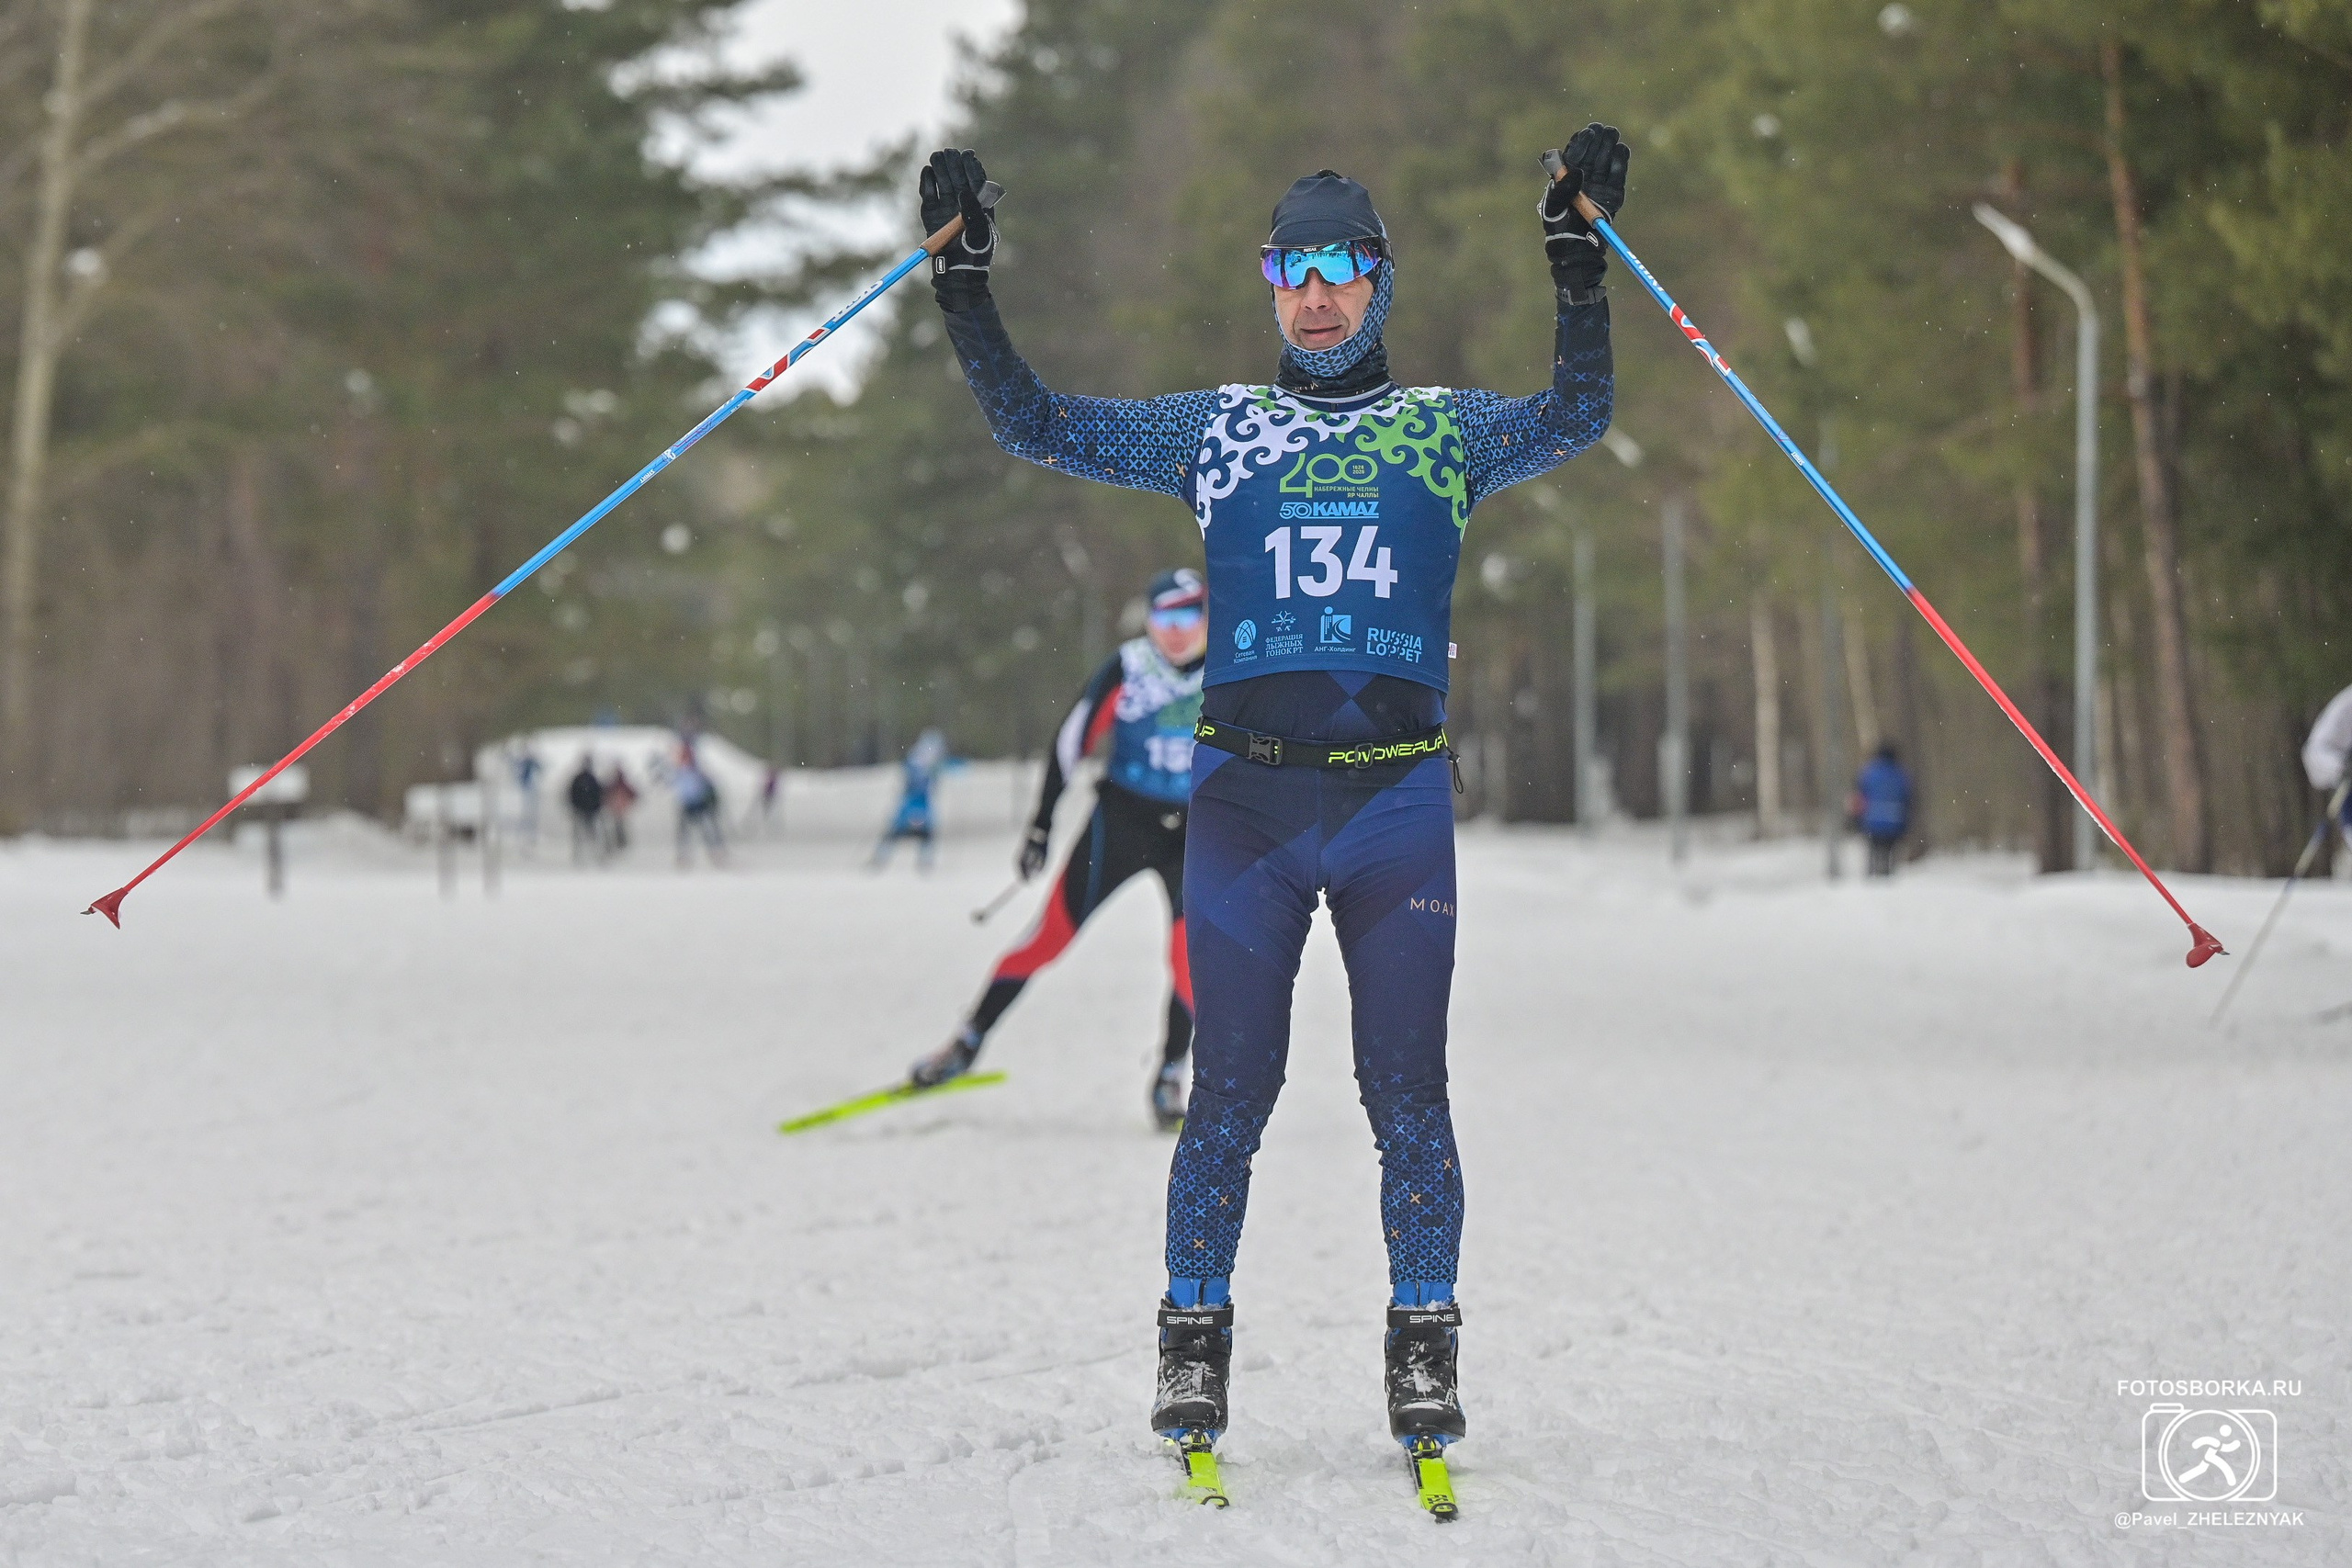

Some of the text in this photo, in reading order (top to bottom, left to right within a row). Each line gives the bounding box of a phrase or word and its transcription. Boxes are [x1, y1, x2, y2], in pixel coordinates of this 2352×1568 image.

[1279, 452, 1378, 499] 400
[1264, 525, 1398, 600] 134
[1264, 633, 1304, 643] ФЕДЕРАЦИЯ
[1367, 627, 1422, 651] RUSSIA
[1265, 639, 1303, 650] ЛЫЖНЫХ
[1265, 648, 1293, 658] ГОНОК
[1366, 641, 1422, 663] LOPPET
[1166, 1315, 1214, 1325] SPINE
[1409, 1314, 1455, 1324] SPINE
